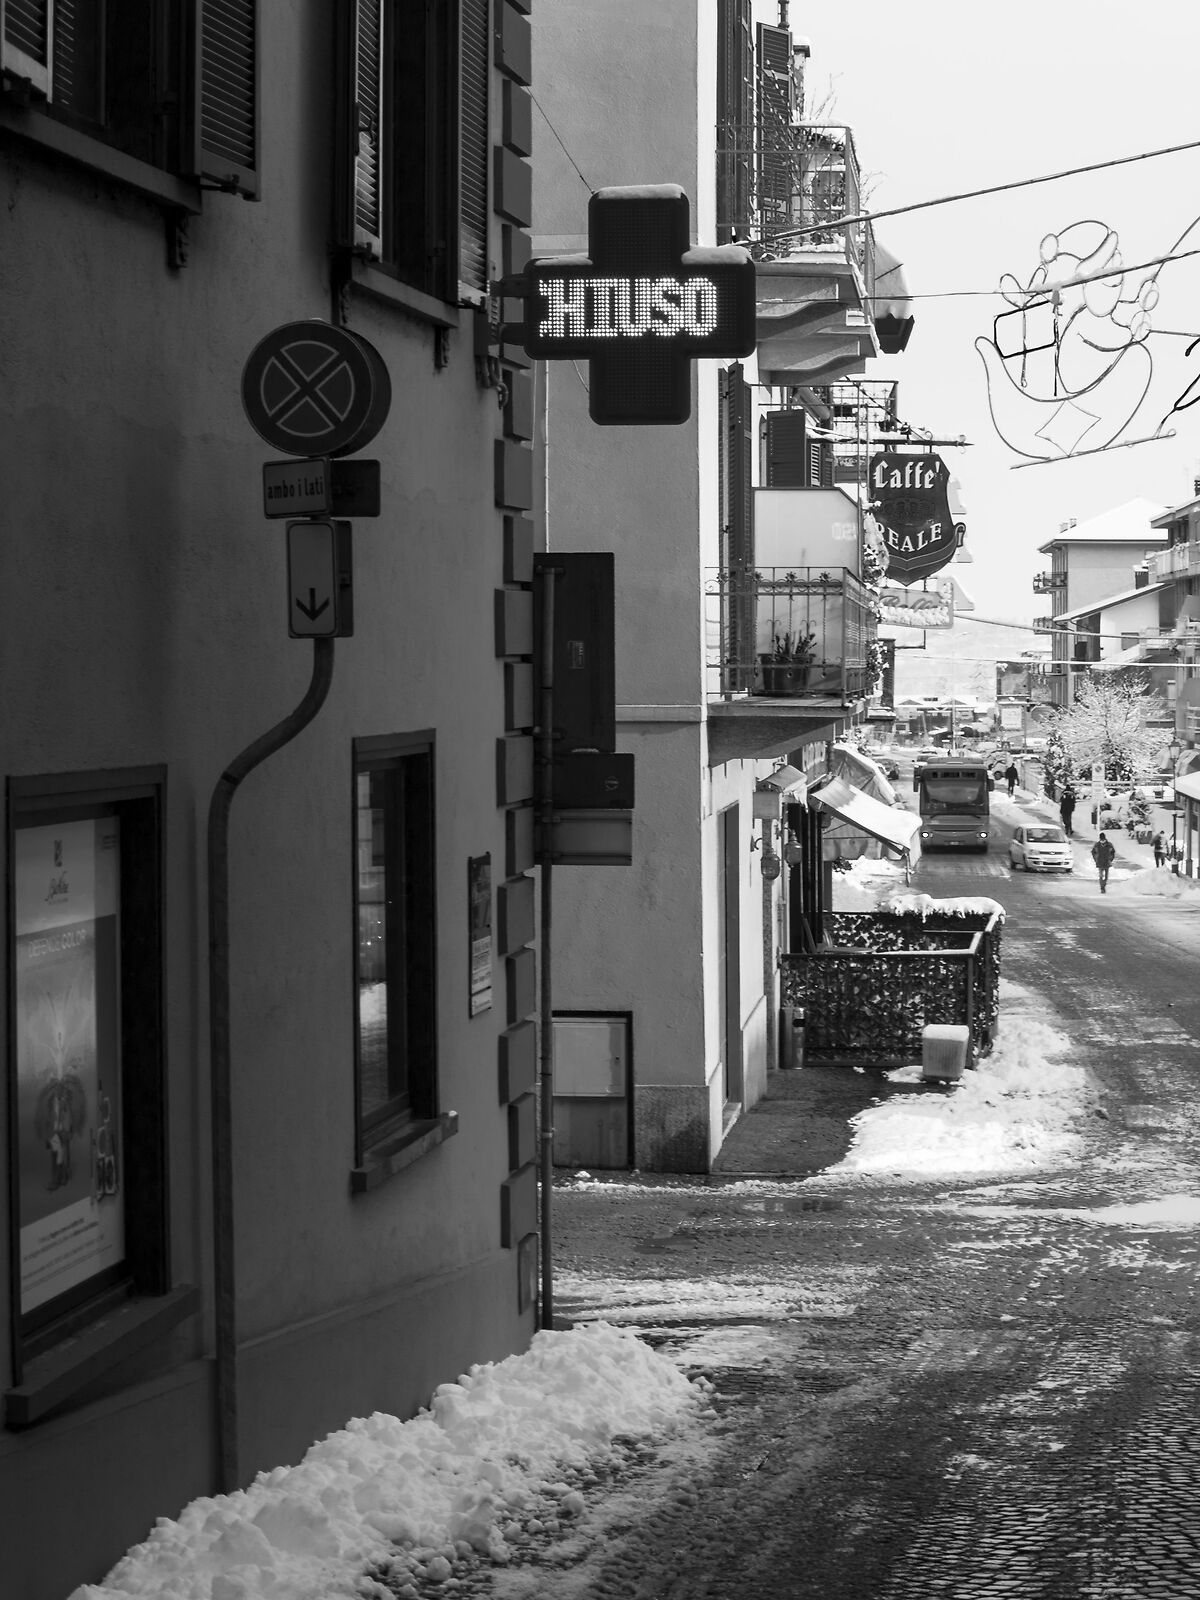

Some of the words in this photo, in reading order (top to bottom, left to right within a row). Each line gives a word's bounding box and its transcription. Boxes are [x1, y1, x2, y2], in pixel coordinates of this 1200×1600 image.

[267, 479, 296, 499] ambo
[298, 478, 302, 497] i
[304, 476, 324, 497] lati
